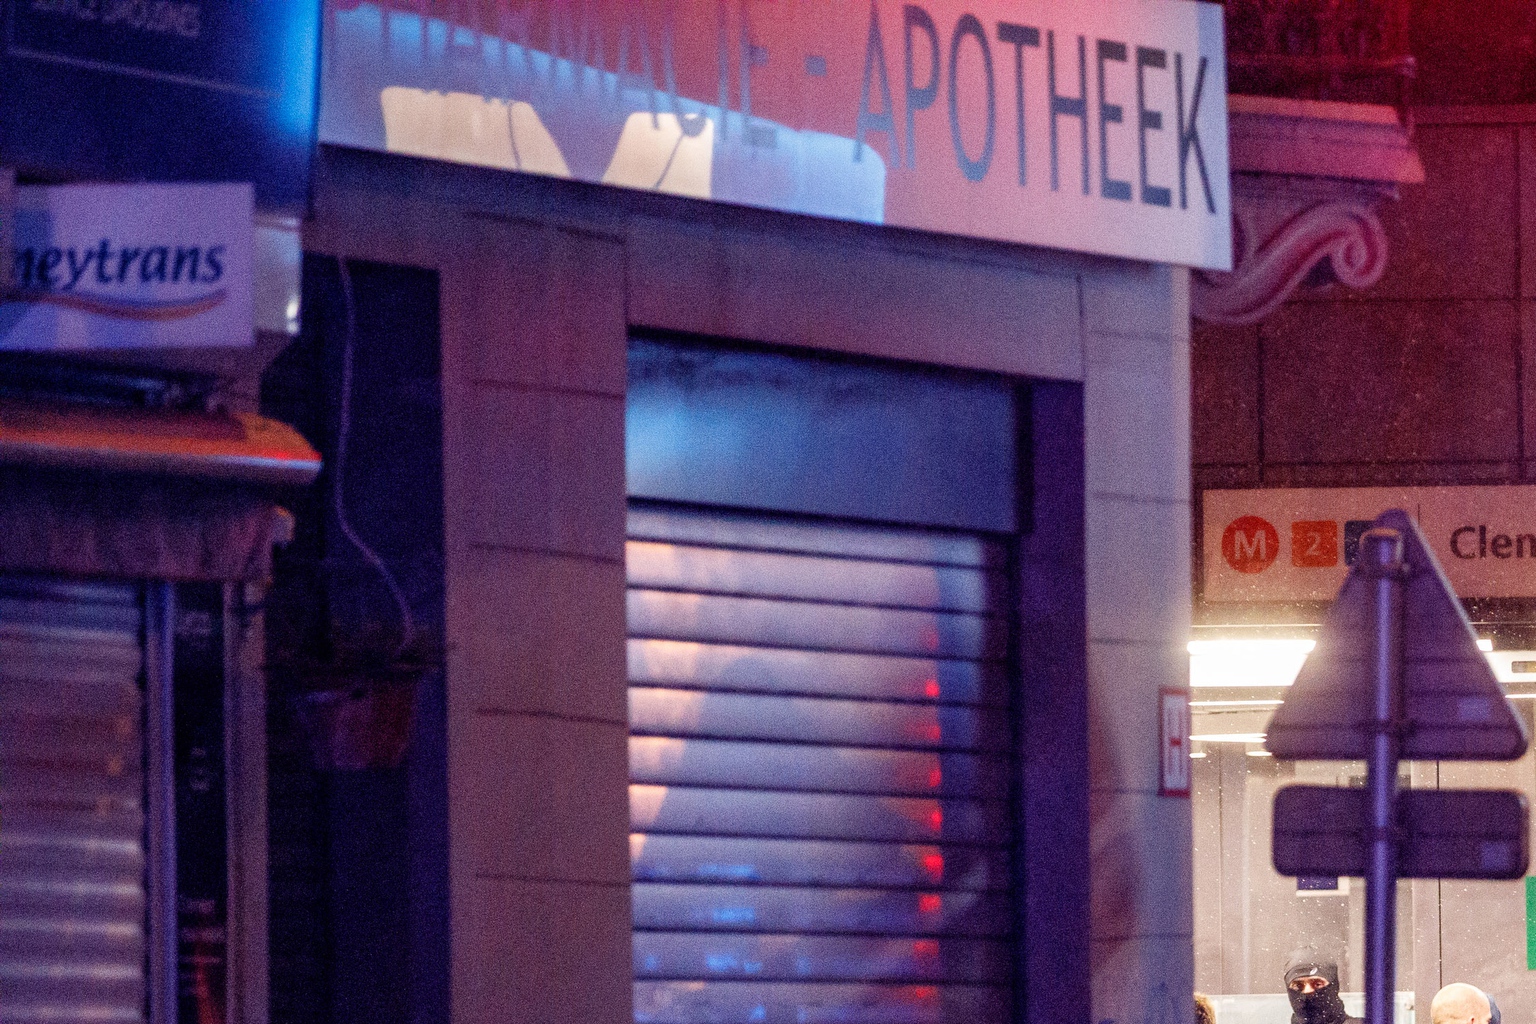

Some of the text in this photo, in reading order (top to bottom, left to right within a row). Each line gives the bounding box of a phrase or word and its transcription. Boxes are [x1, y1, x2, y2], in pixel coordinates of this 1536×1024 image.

[852, 0, 1216, 214] APOTHEEK
[1234, 529, 1266, 560] M
[1305, 531, 1321, 556] 2
